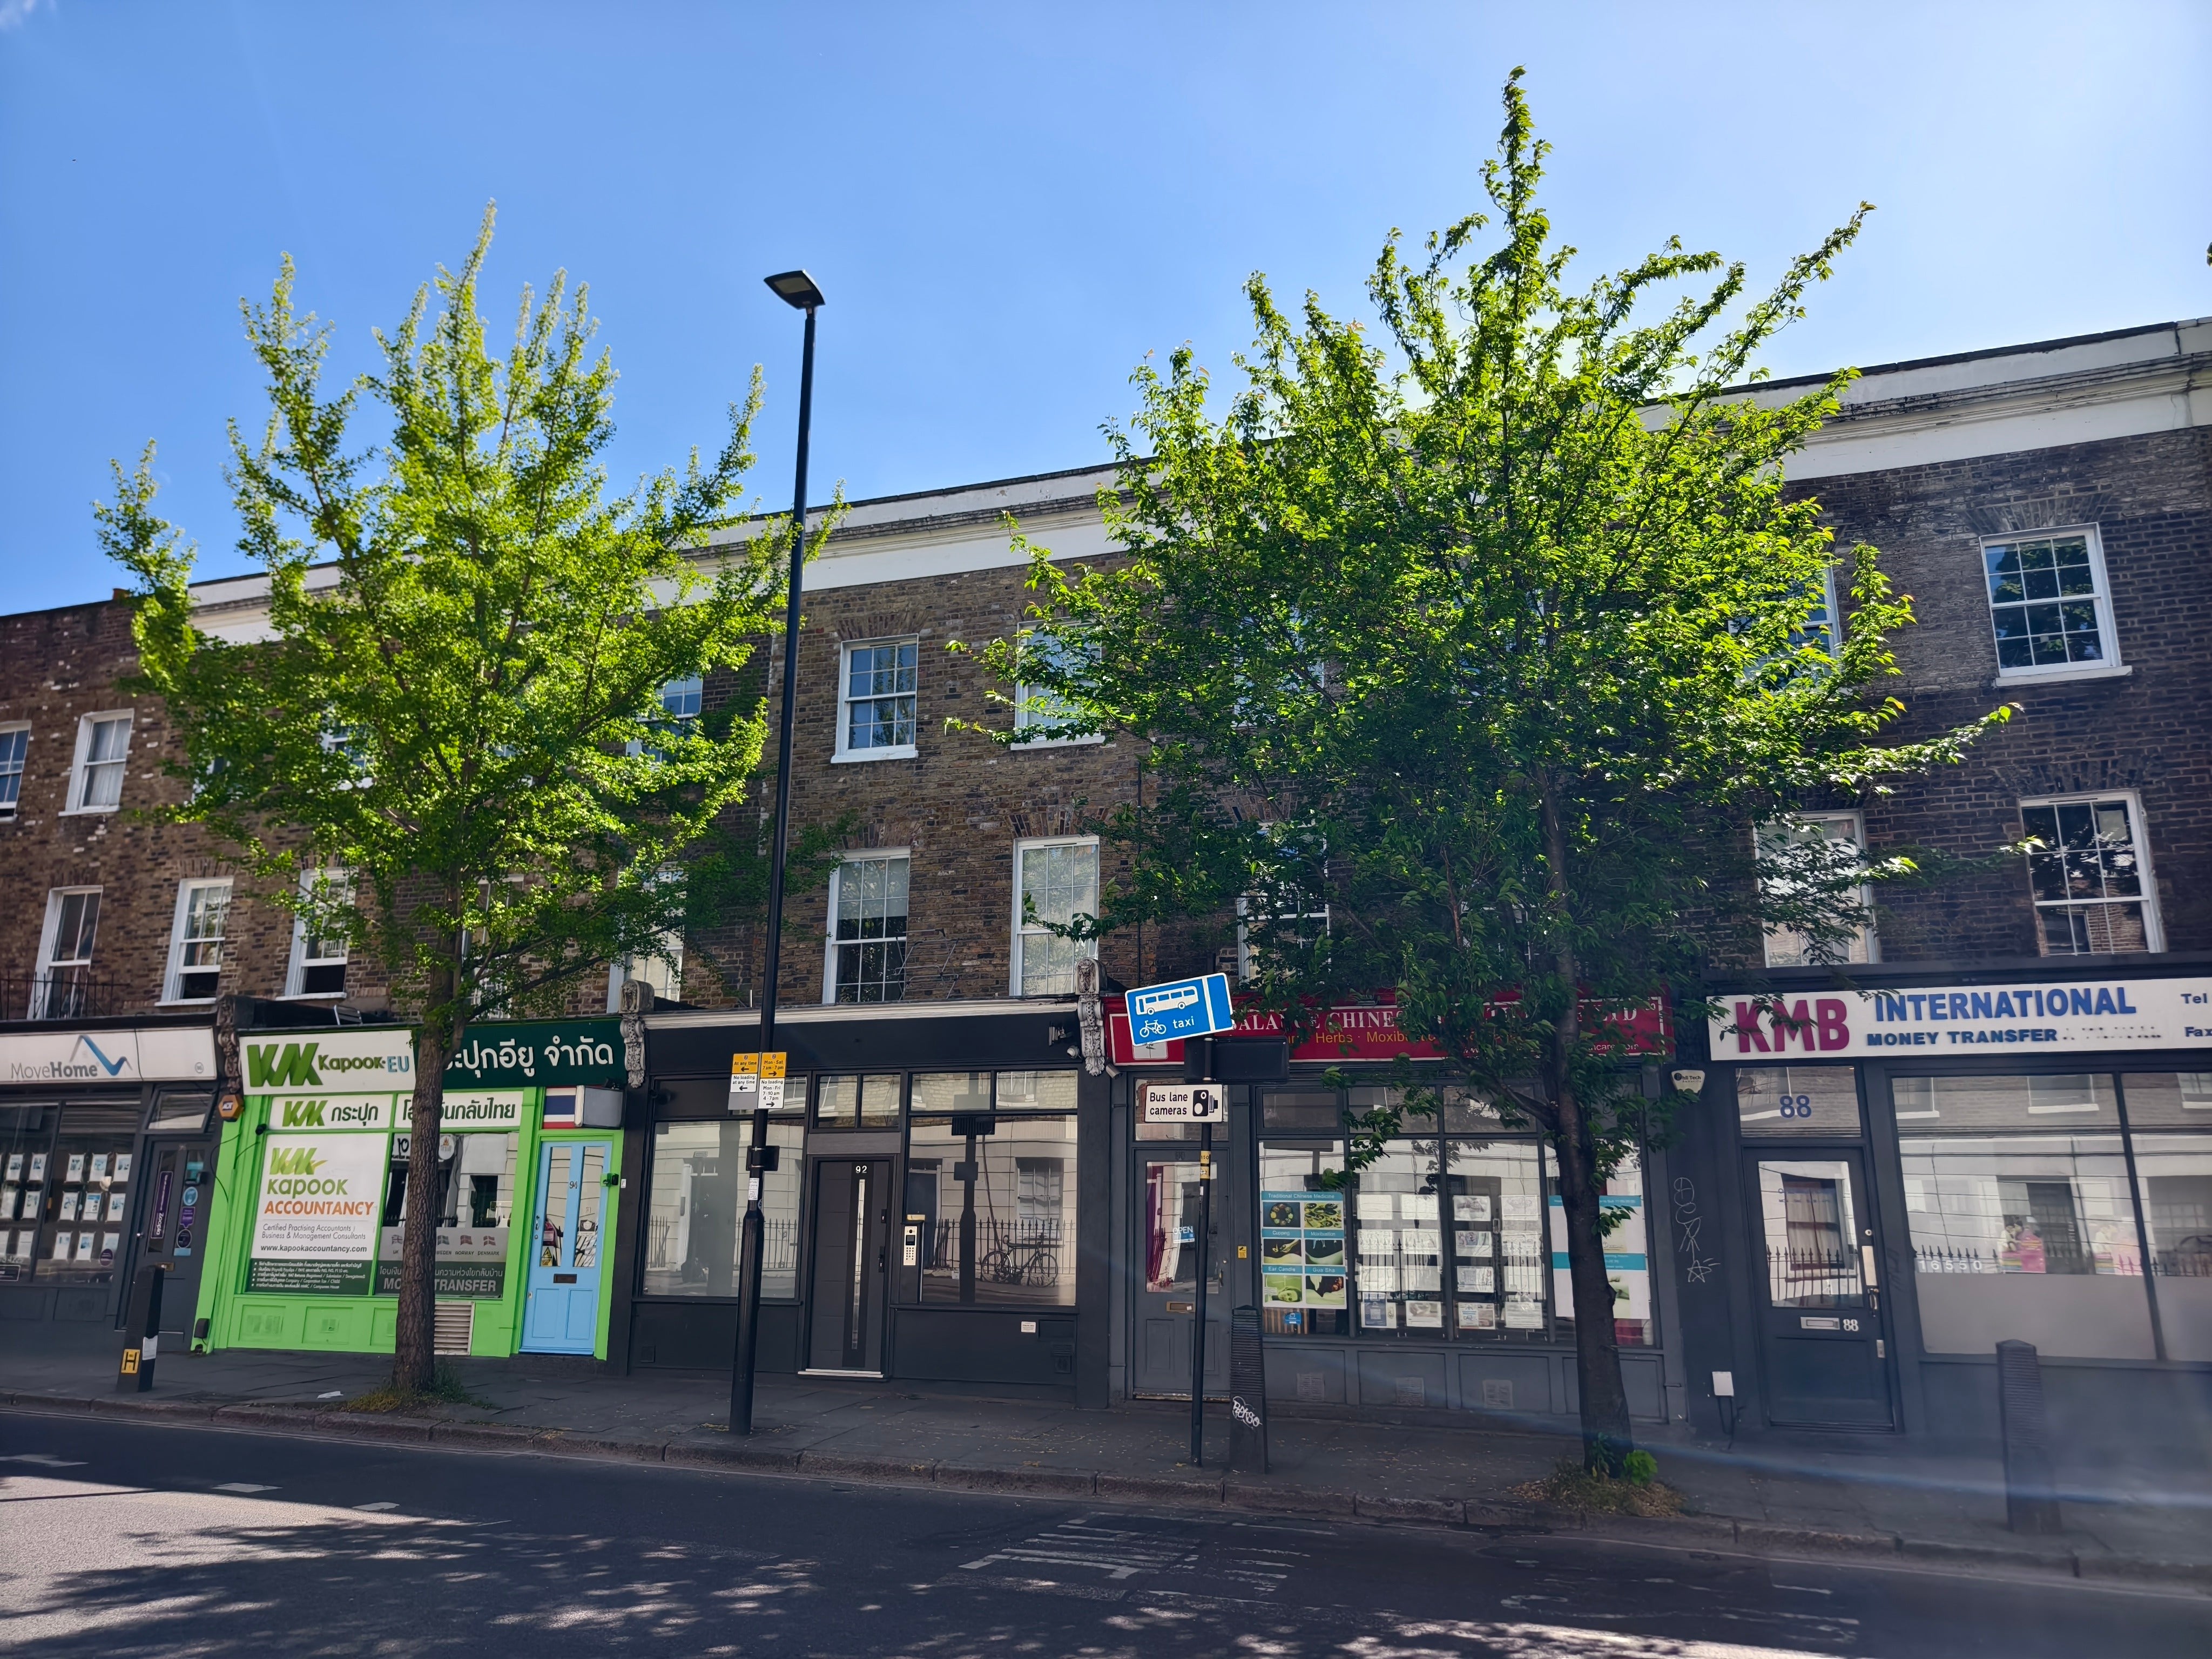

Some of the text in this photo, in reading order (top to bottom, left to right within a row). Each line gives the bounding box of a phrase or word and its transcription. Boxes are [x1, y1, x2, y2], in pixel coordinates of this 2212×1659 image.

[1874, 987, 2136, 1021] INTERNATIONAL
[2181, 993, 2208, 1004] Tel
[1172, 1016, 1195, 1029] taxi
[1735, 999, 1850, 1053] KMB
[1316, 1032, 1352, 1043] Herbs
[1867, 1028, 2058, 1046] MONEY TRANSFER
[2185, 1026, 2212, 1037] Fax
[544, 1035, 614, 1067] จำกัด
[11, 1062, 98, 1079] MoveHome
[1150, 1092, 1188, 1102] Bus lane
[1780, 1095, 1812, 1118] 88
[331, 1103, 378, 1126] กระปุก
[855, 1165, 867, 1174] 92
[569, 1181, 578, 1189] 94
[264, 1201, 374, 1215] ACCOUNTANCY
[288, 1224, 315, 1232] Practising
[1172, 1226, 1193, 1234] OPEN
[435, 1278, 496, 1291] TRANSFER
[1843, 1319, 1859, 1331] 88
[124, 1352, 137, 1371] H
